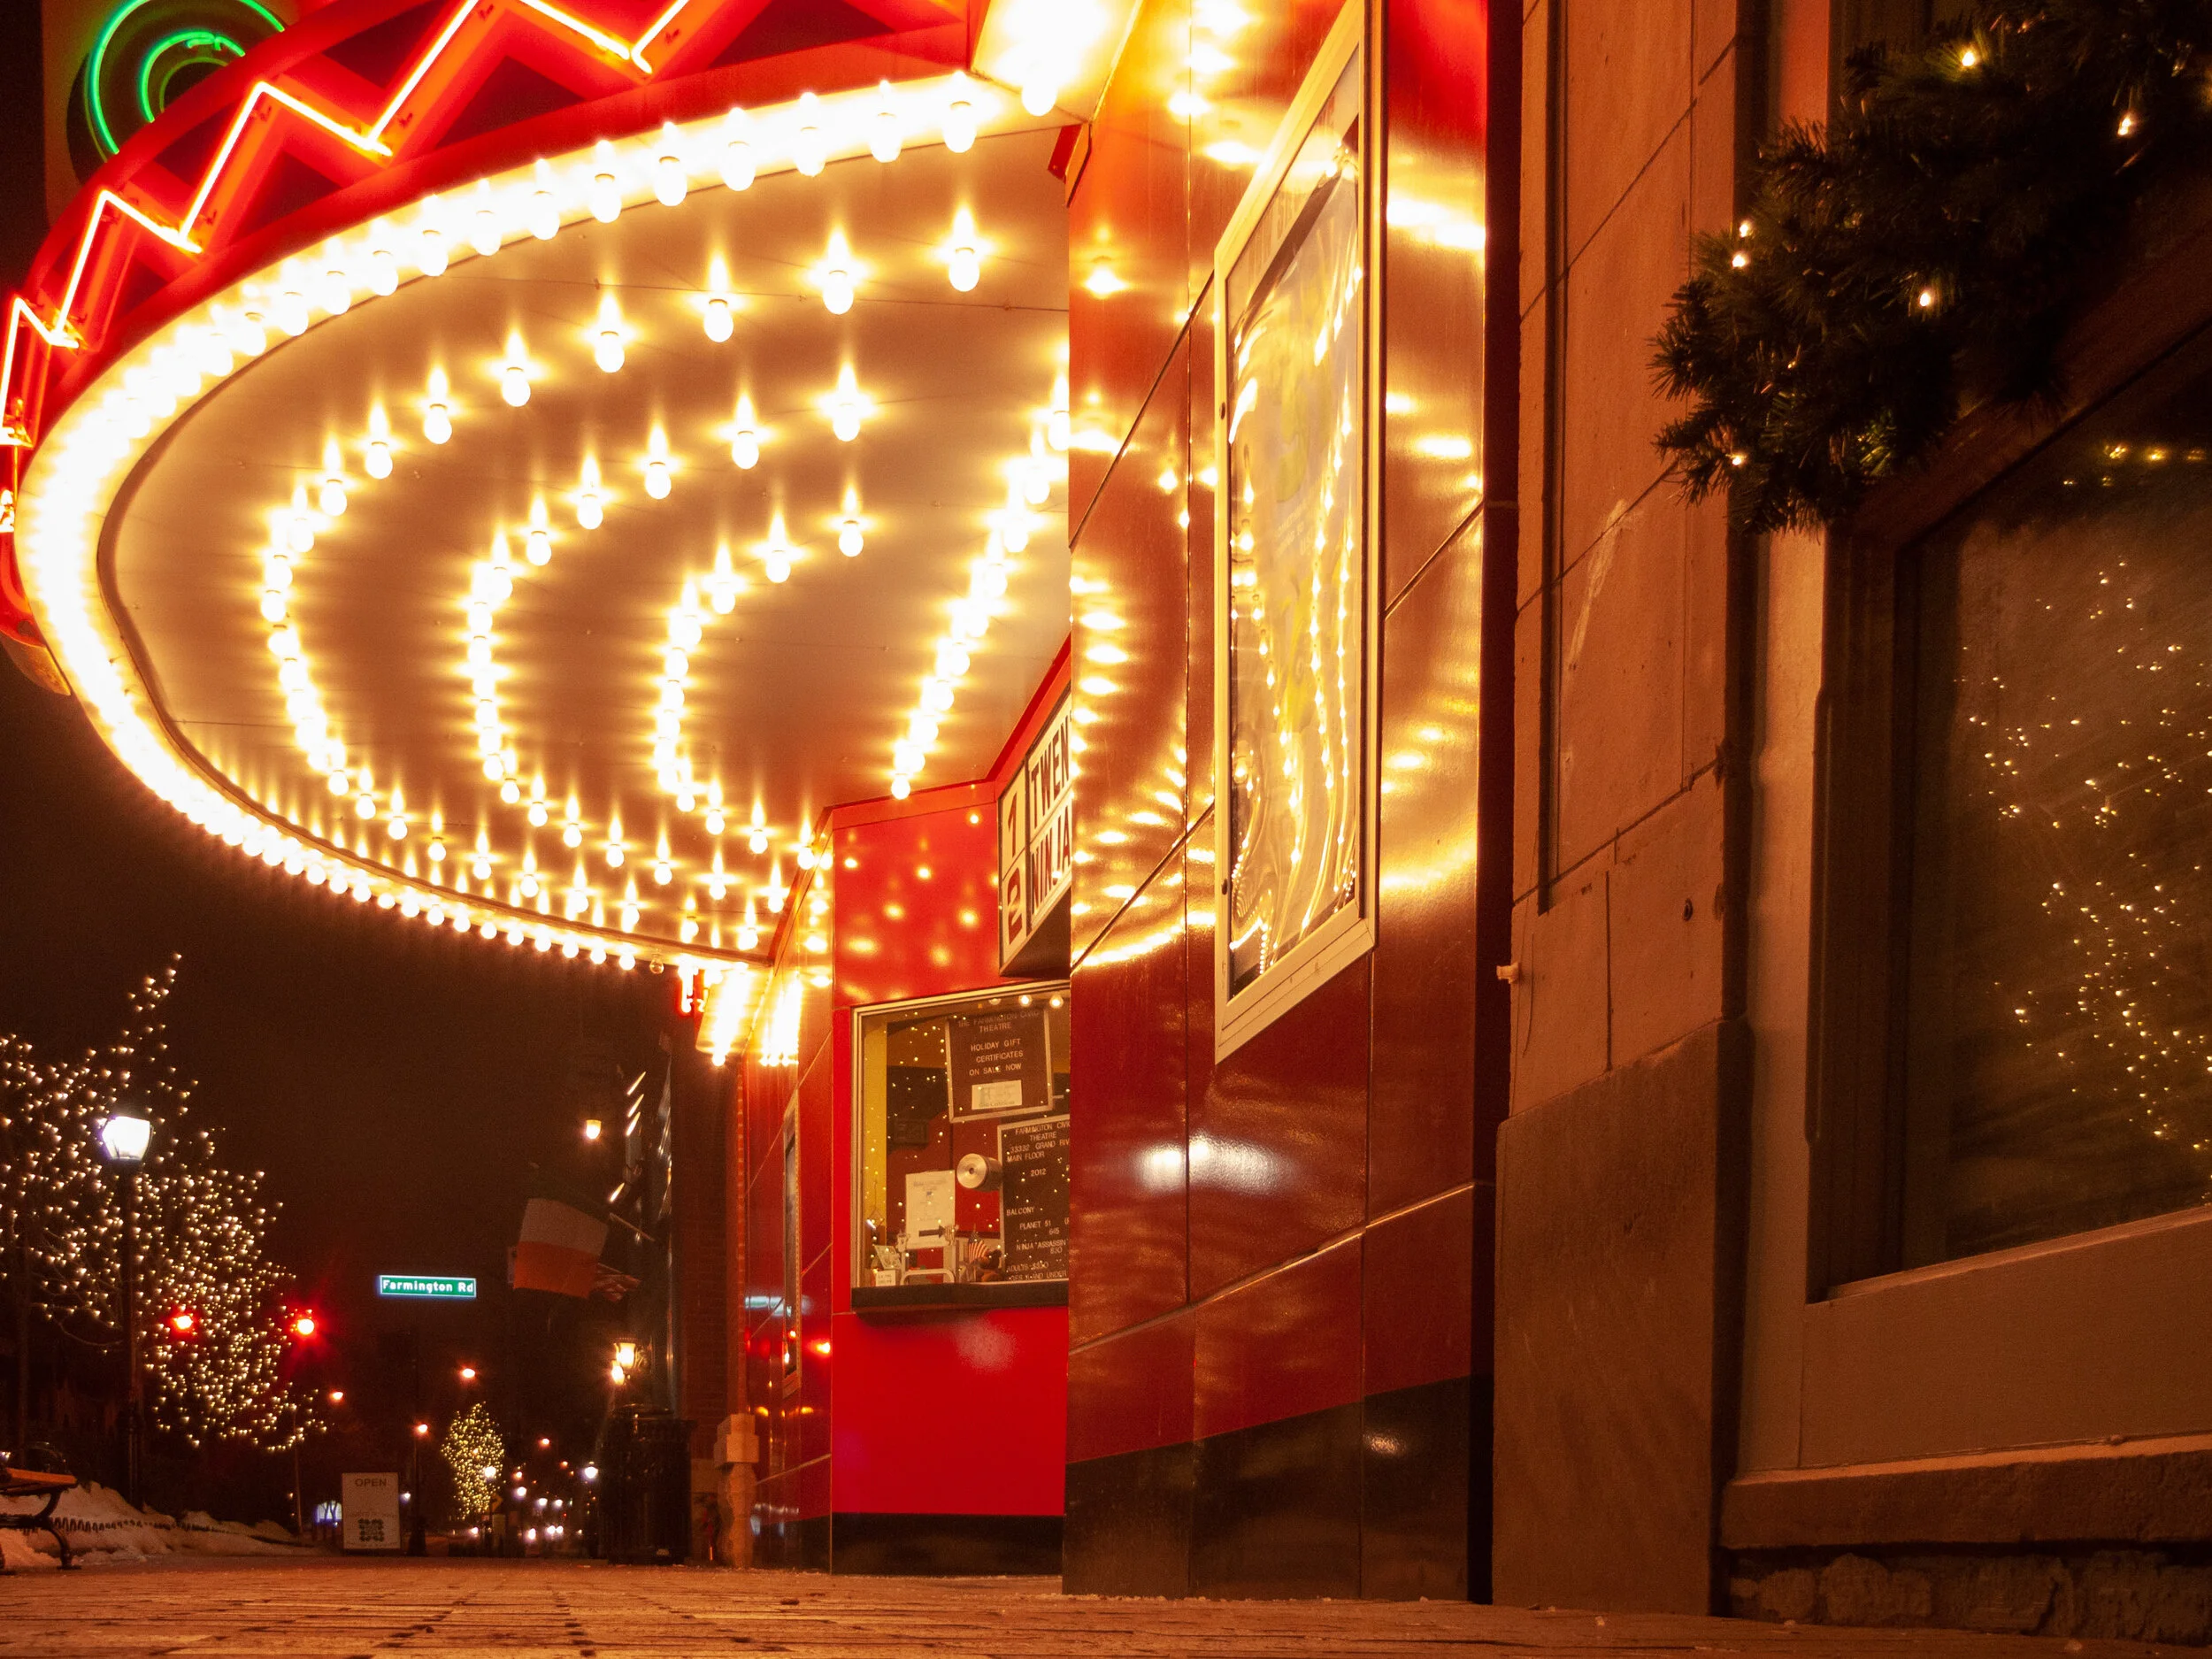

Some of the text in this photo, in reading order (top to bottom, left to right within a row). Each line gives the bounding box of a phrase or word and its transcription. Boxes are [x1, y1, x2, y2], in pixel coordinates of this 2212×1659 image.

[1008, 710, 1071, 859] 1 TWEN
[1007, 805, 1071, 946] 2 NINJA
[979, 1022, 1012, 1033] THEATRE
[971, 1038, 1021, 1052] HOLIDAY GIFT
[976, 1050, 1024, 1063] CERTIFICATES
[1030, 1131, 1057, 1141] THEATRE
[1035, 1140, 1056, 1150] GRAND
[1007, 1151, 1045, 1163] MAIN FLOOR
[1030, 1168, 1047, 1178] 2012
[1006, 1206, 1035, 1217] BALCONY
[1019, 1220, 1041, 1230] PLANET
[1016, 1239, 1067, 1251] NINJA ASSASSIN
[382, 1279, 473, 1294] Farmington Rd
[355, 1478, 387, 1487] OPEN
